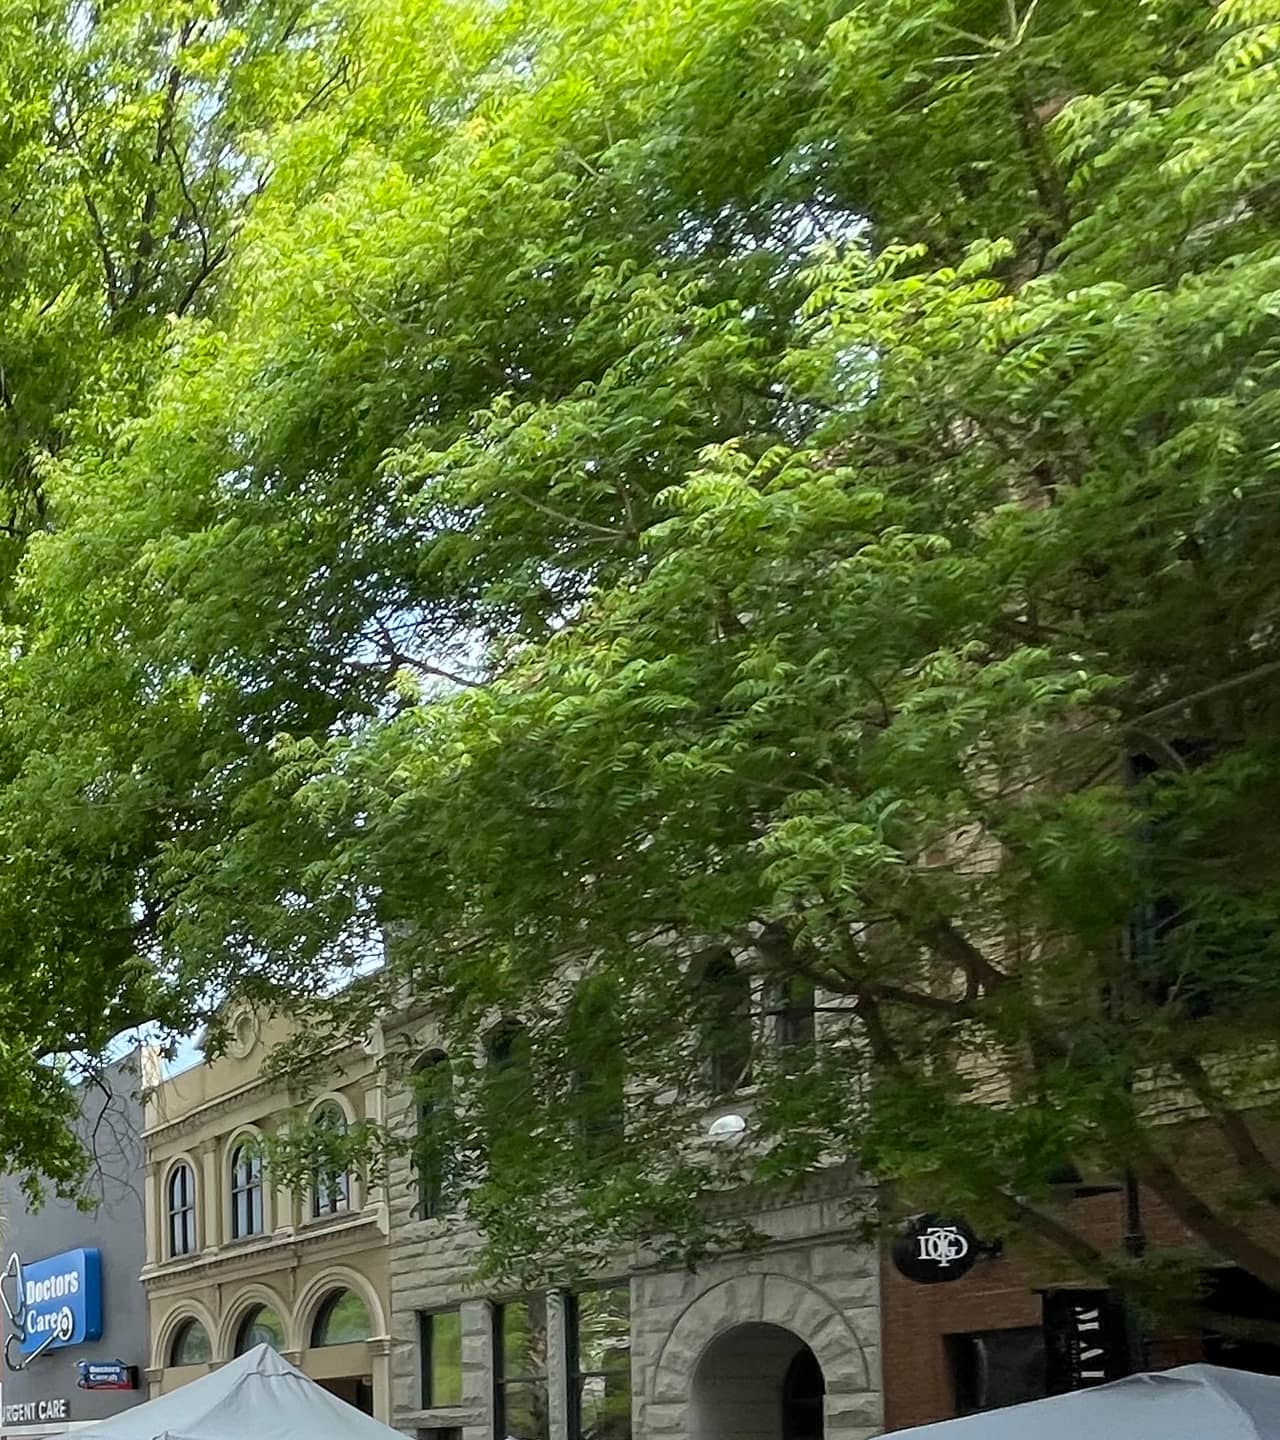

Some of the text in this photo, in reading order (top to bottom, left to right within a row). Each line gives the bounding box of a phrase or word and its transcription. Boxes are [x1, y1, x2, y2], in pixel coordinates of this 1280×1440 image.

[26, 1271, 80, 1305] Doctors
[27, 1307, 59, 1334] Care
[38, 1399, 68, 1419] CARE
